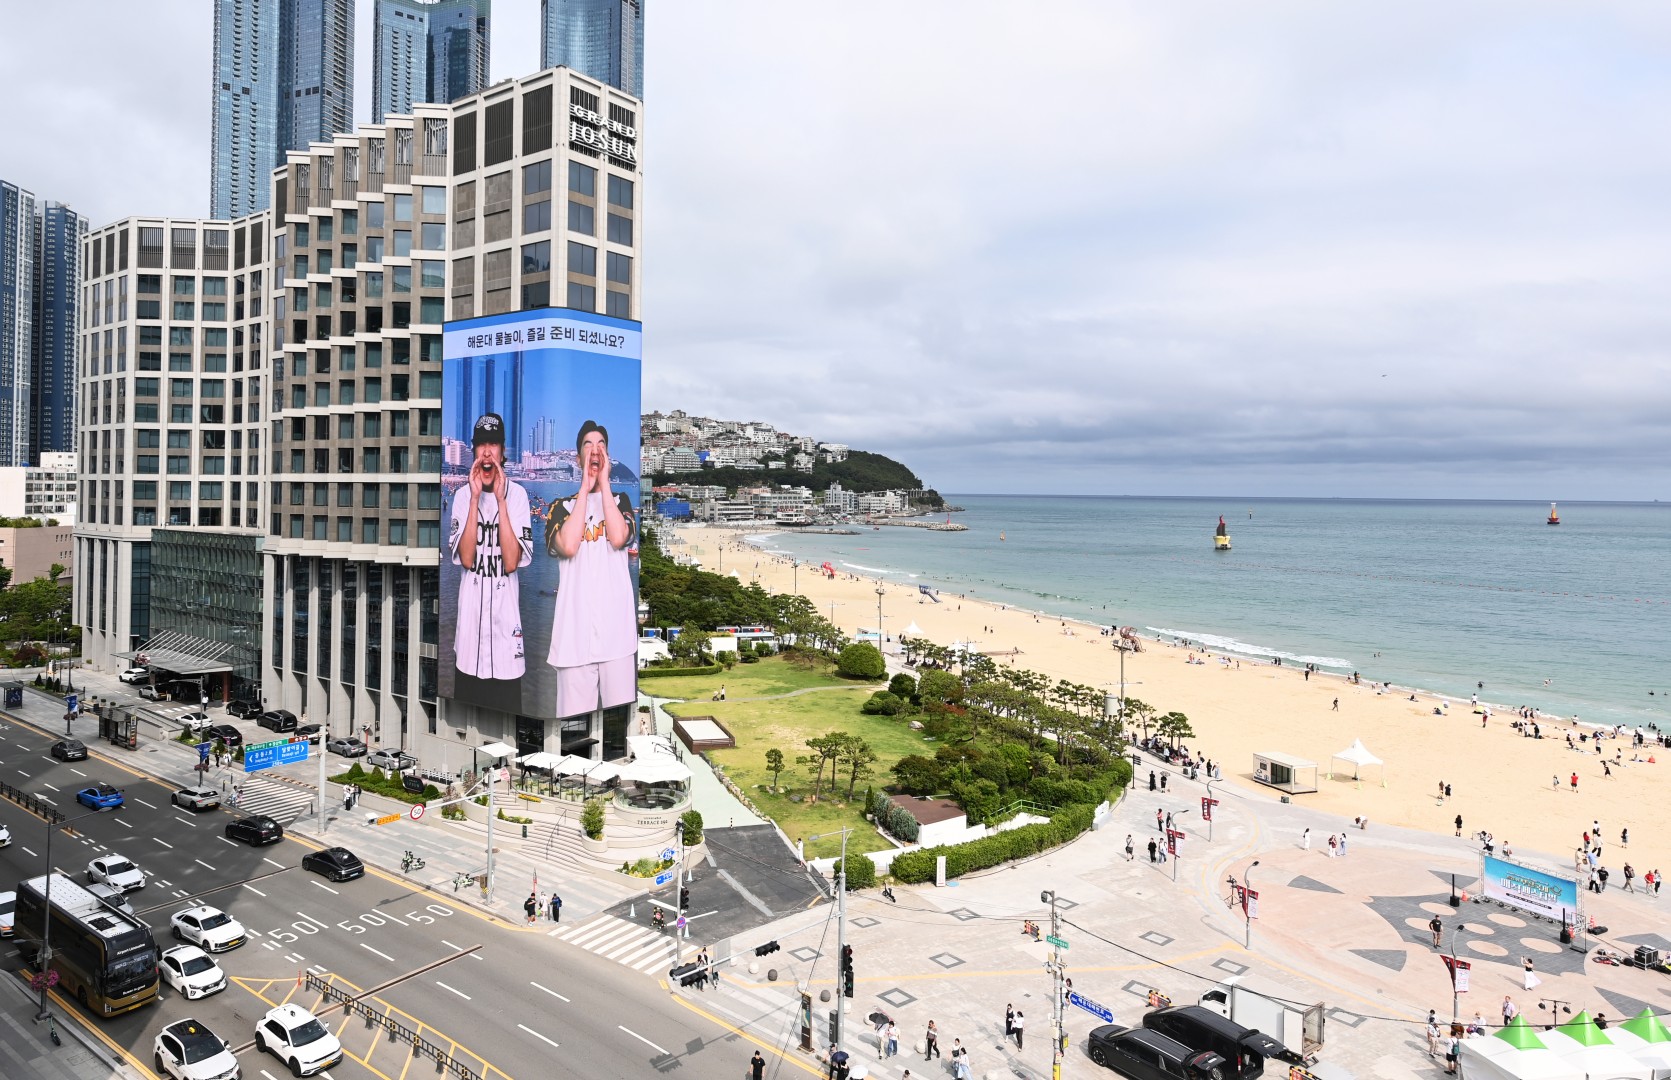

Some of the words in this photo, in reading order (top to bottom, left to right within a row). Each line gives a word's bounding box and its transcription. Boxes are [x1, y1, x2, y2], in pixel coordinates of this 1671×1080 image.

[574, 105, 636, 138] GRAND
[571, 121, 637, 162] JOSUN
[467, 334, 493, 349] 해운대
[495, 330, 524, 346] 물놀이,
[527, 327, 546, 342] 즐길
[550, 326, 575, 341] 준비
[578, 329, 625, 349] 되셨나요?
[337, 913, 386, 934] 50
[405, 904, 454, 925] 50
[267, 920, 320, 943] 50
